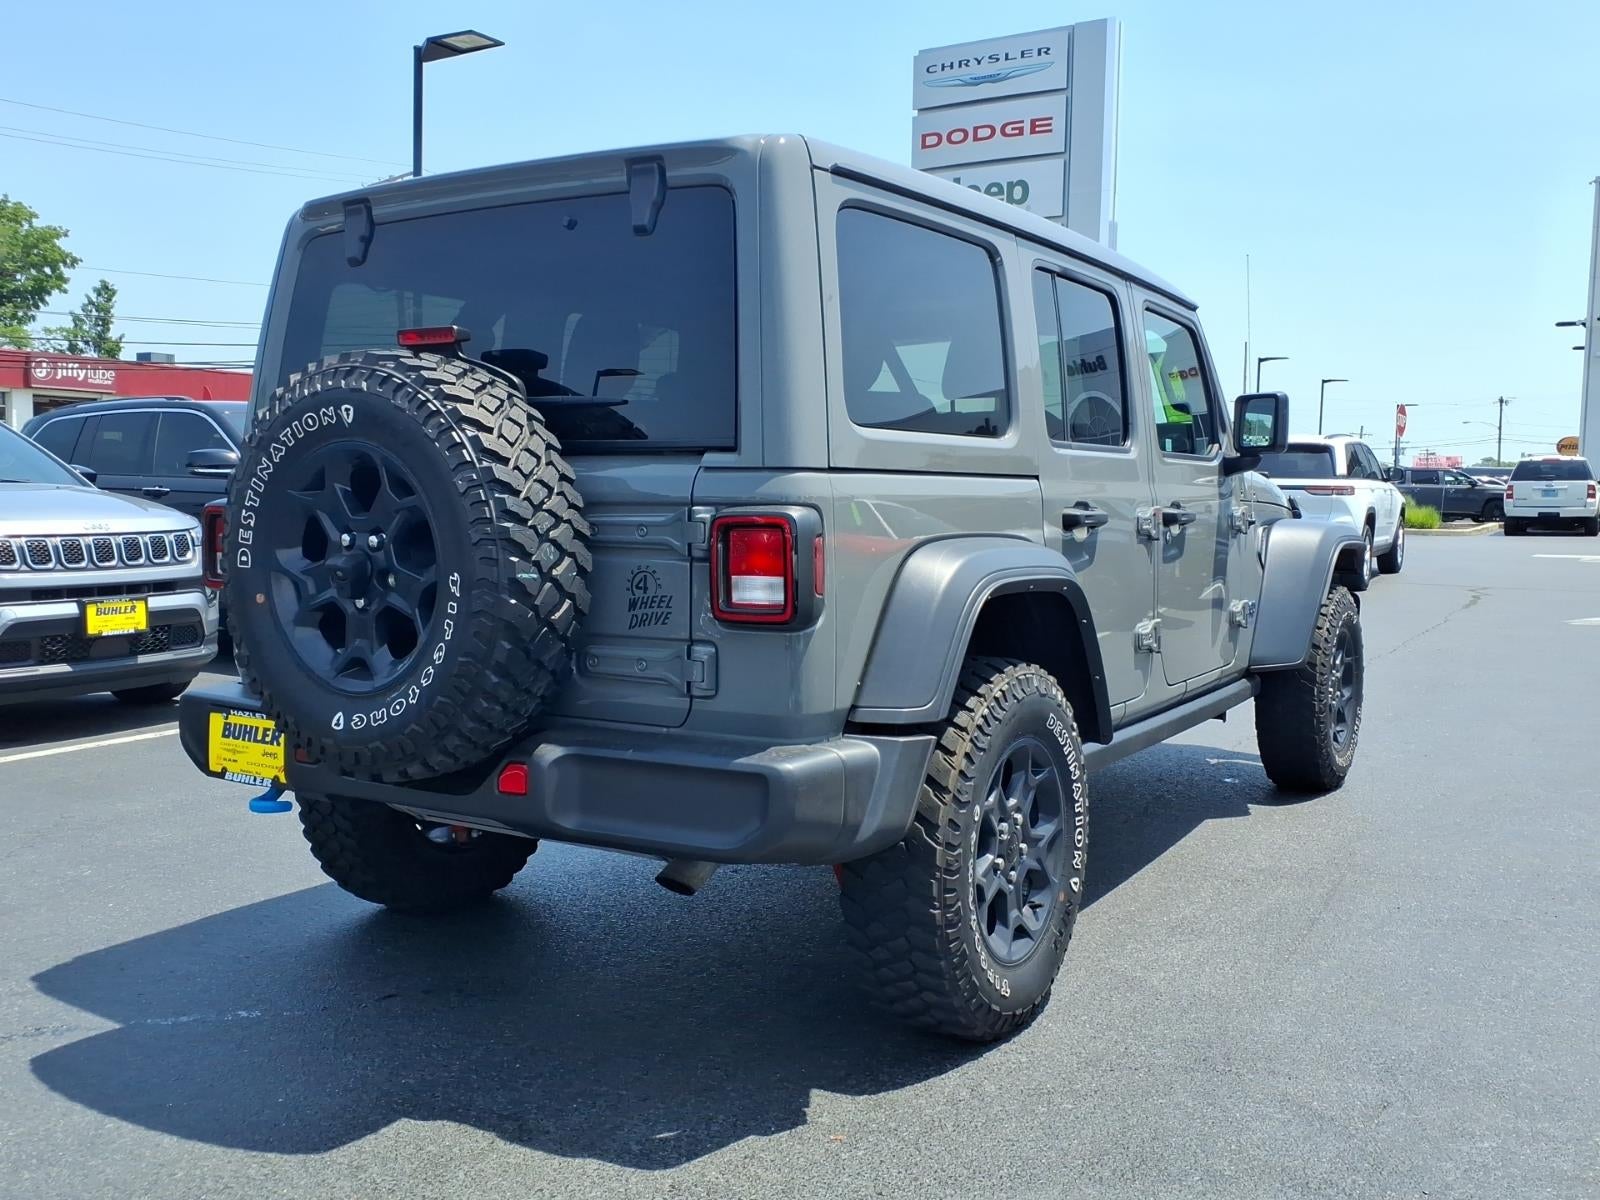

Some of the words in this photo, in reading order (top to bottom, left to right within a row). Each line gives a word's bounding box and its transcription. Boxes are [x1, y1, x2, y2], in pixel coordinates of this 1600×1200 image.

[926, 47, 1051, 74] CHRYSLER
[921, 117, 1053, 149] DODGE
[56, 362, 86, 381] jiffy
[88, 364, 115, 380] lube
[236, 405, 337, 568] DESTINATION
[635, 574, 649, 594] 4
[95, 604, 137, 616] BUHLER
[628, 595, 673, 612] WHEEL
[629, 611, 673, 630] DRIVE
[221, 722, 281, 747] BUHLER
[261, 749, 279, 760] Jeep
[224, 771, 272, 787] BUHLER
[1047, 713, 1084, 869] DESTINATION
